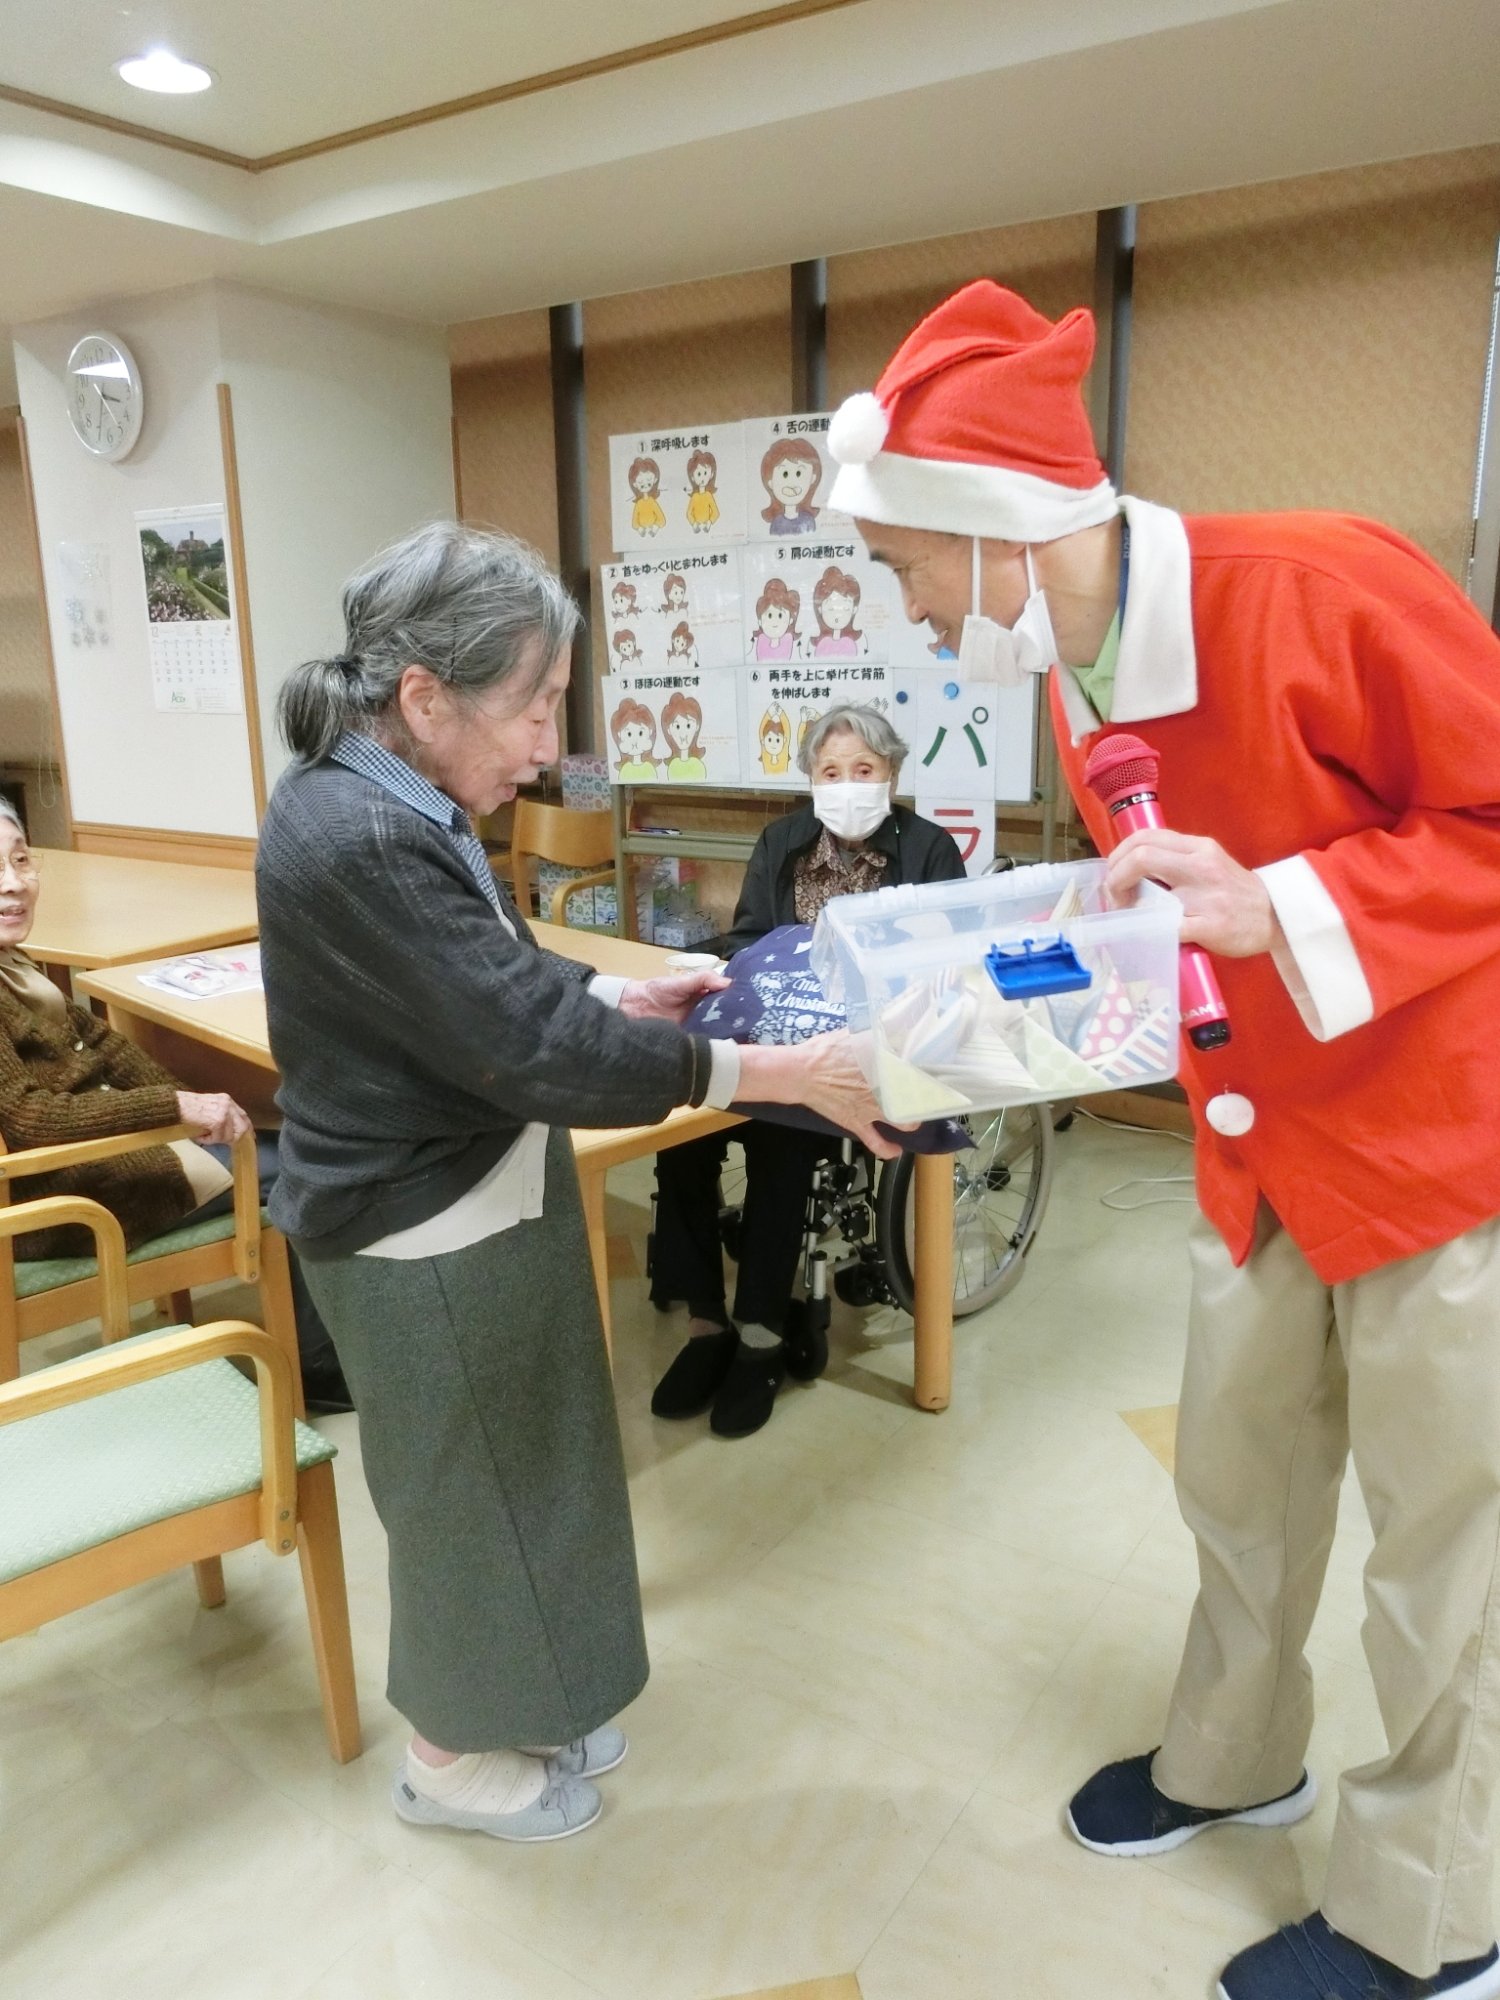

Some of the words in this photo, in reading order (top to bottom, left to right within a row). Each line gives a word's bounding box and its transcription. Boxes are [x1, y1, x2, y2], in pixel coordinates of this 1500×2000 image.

[651, 434, 710, 452] 深呼吸します
[791, 545, 855, 560] 肩の運動です
[622, 554, 728, 577] 首をゆっくりとまわします
[634, 675, 700, 690] ほほの運動です
[769, 668, 885, 681] 両手を上に挙げて背筋
[771, 687, 832, 699] を伸ばします
[922, 706, 989, 768] パ
[776, 992, 846, 1016] Christmas
